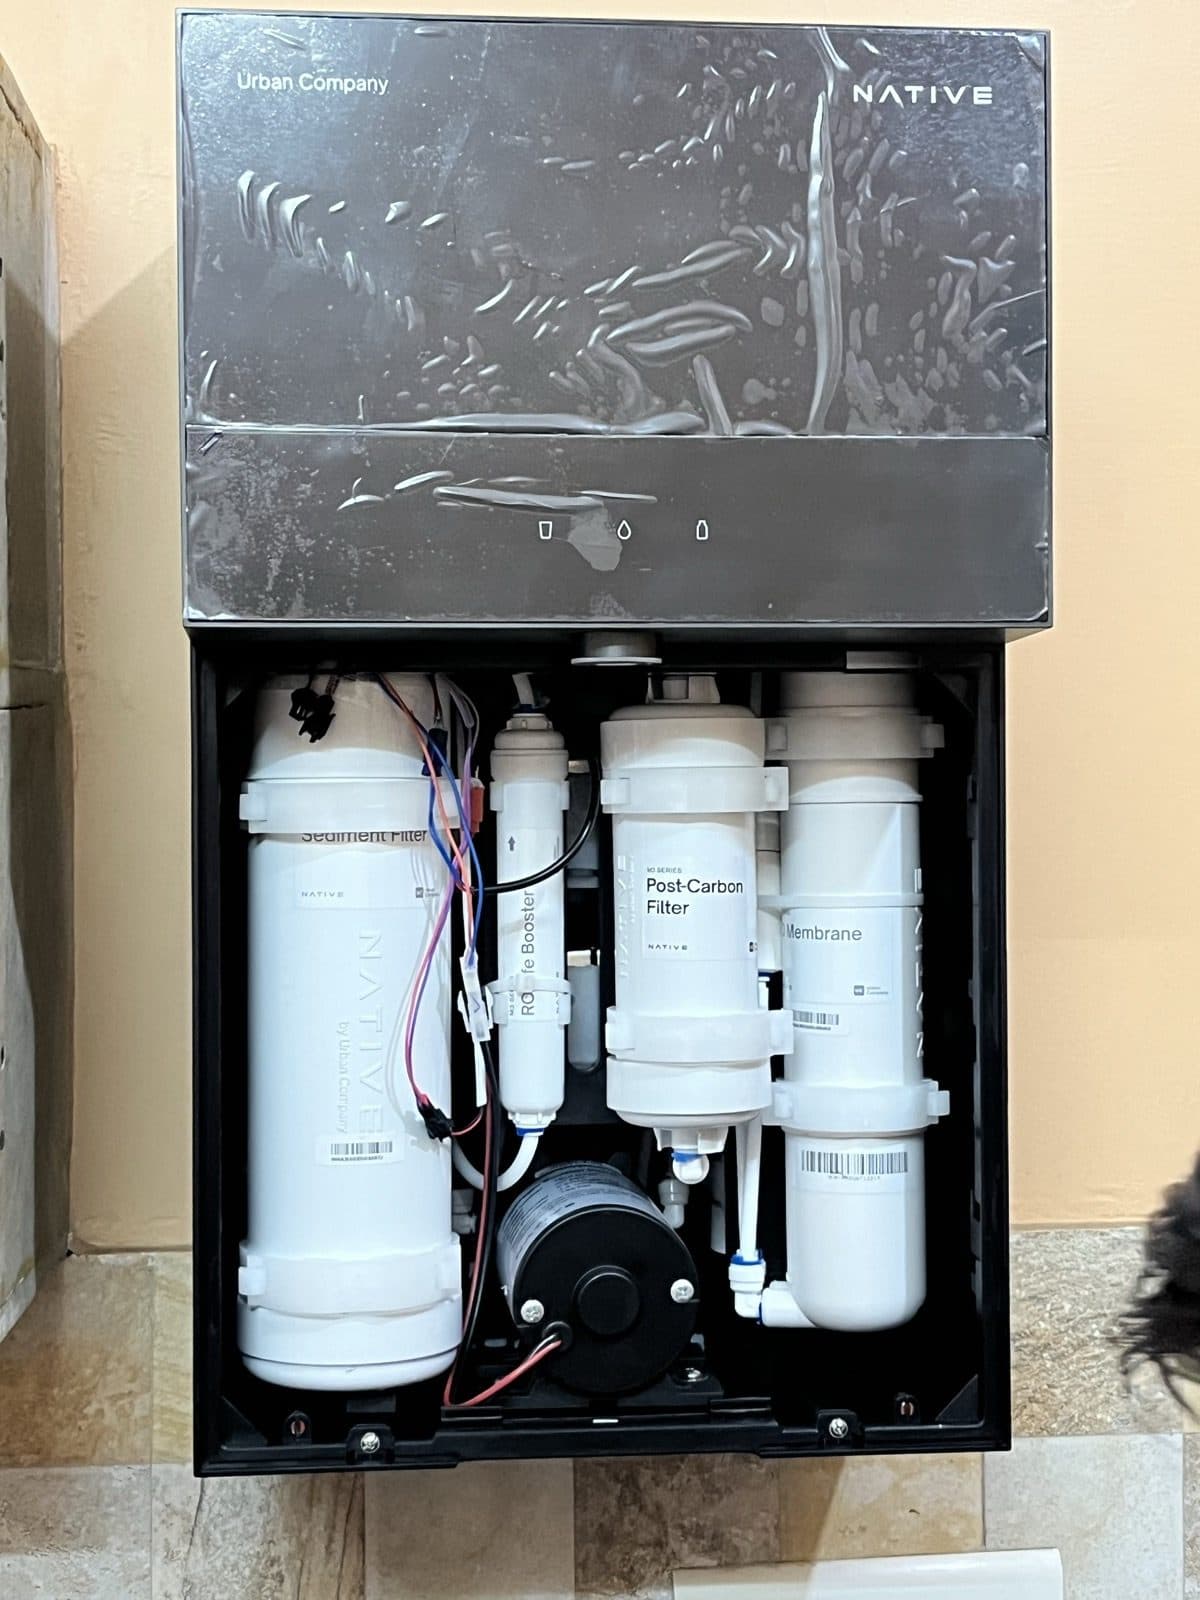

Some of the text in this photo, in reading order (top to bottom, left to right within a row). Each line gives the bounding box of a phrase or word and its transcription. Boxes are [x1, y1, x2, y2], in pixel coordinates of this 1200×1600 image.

[237, 72, 389, 95] Urban Company
[853, 84, 993, 105] NATIVE
[301, 890, 344, 898] NATIVE
[646, 878, 743, 893] Post-Carbon
[646, 899, 690, 914] Filter
[521, 890, 535, 954] Booster
[786, 923, 863, 941] Membrane
[648, 943, 688, 951] NATIVE
[359, 930, 384, 1135] NATIVE
